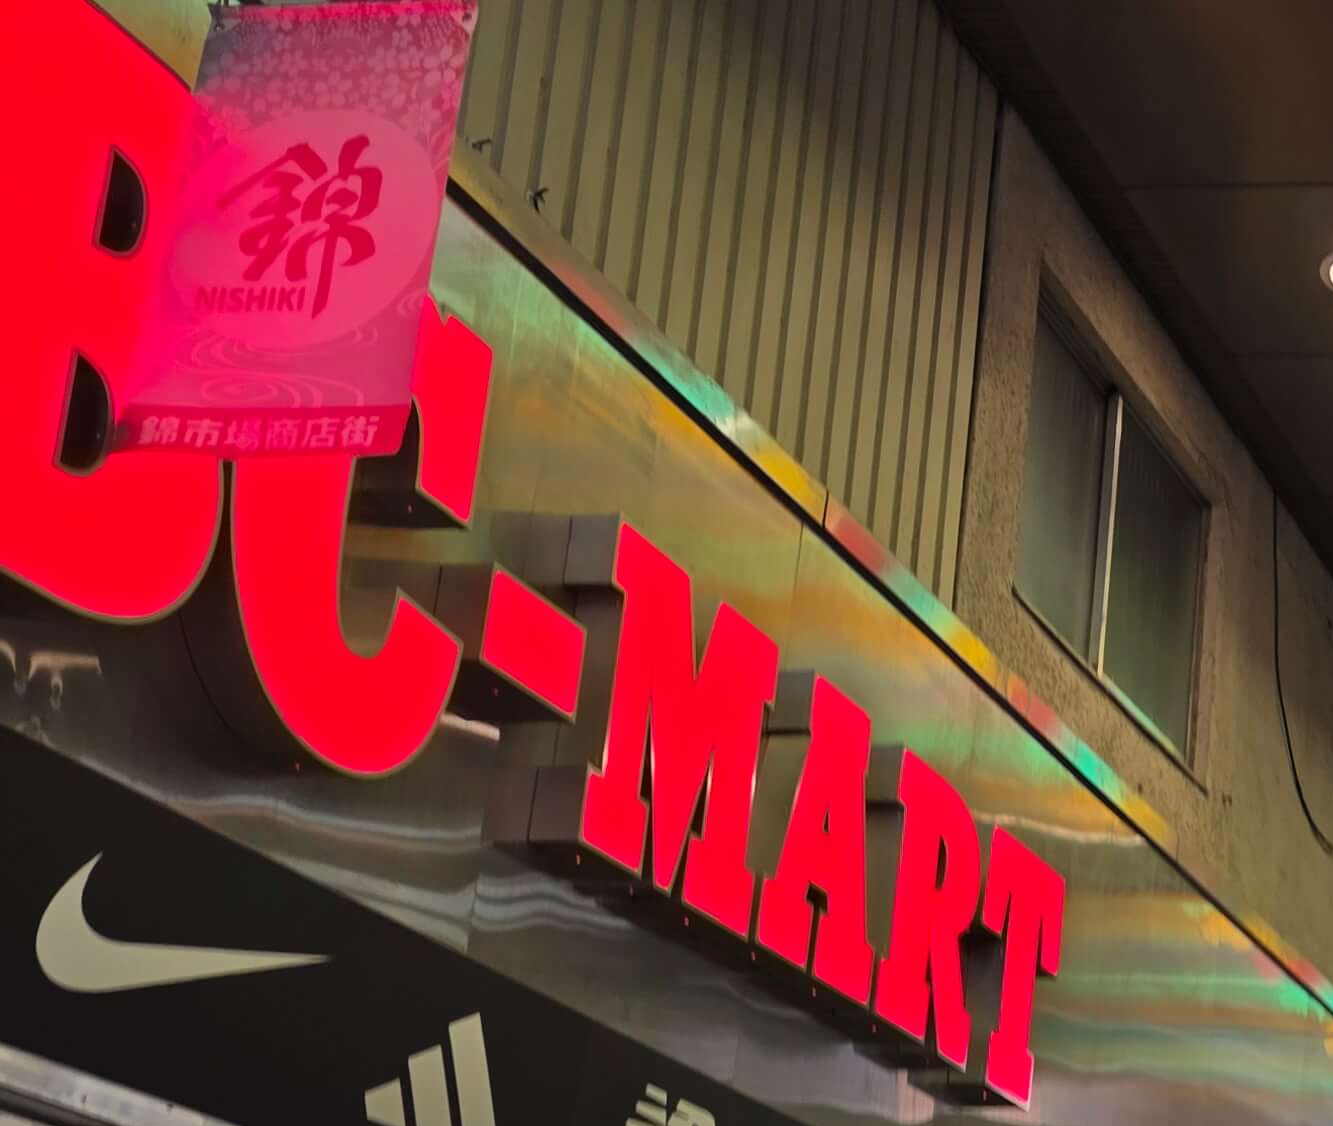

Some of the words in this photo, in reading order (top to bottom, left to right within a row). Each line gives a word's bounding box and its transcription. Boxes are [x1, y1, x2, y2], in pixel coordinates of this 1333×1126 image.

[215, 134, 383, 320] 錦
[195, 285, 306, 314] NISHIKI
[137, 414, 381, 449] 錦市場商店街
